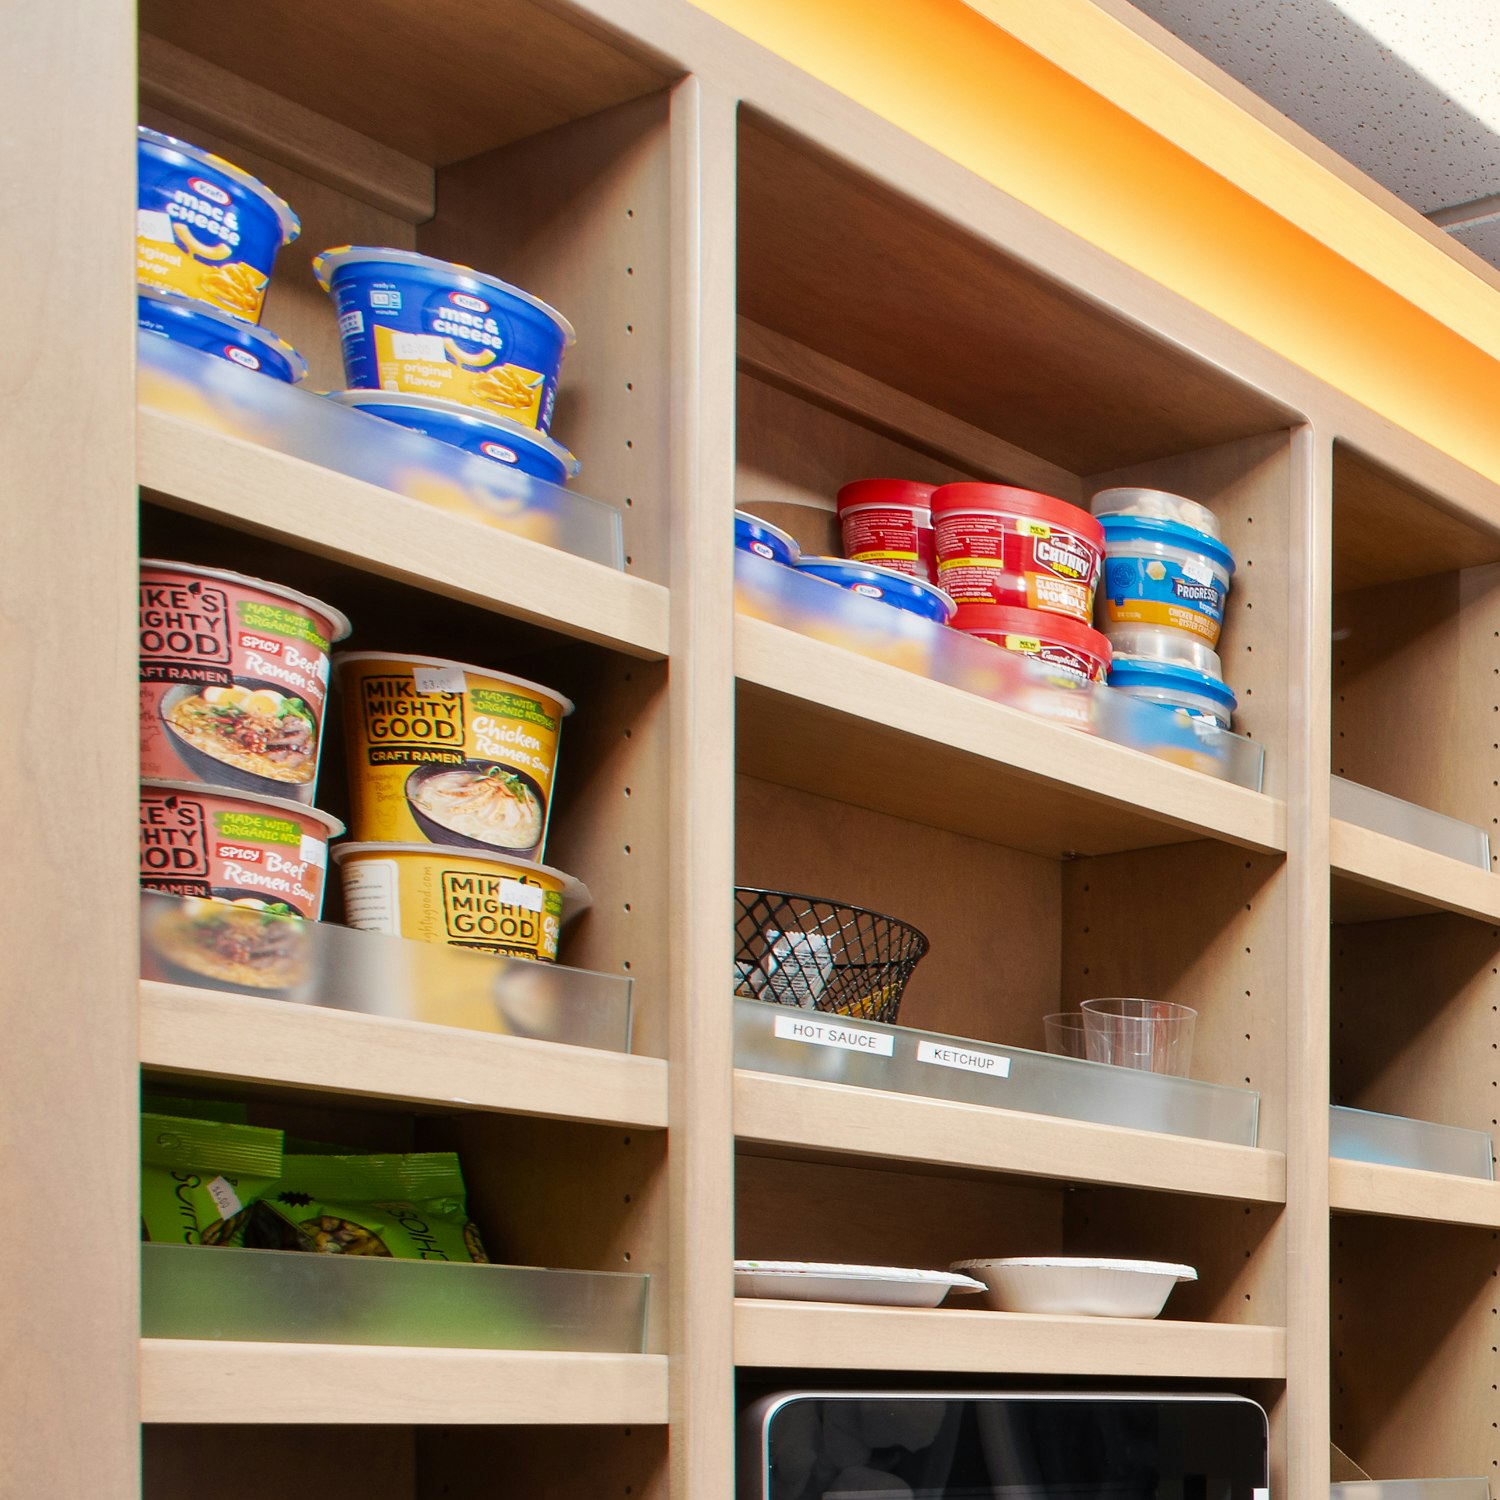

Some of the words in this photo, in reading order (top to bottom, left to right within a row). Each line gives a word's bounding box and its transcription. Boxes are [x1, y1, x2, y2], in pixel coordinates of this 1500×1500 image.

[223, 212, 238, 231] &
[439, 307, 483, 329] mac
[483, 316, 499, 335] &
[403, 363, 453, 379] original
[404, 375, 442, 389] flavor
[1039, 542, 1089, 576] CHUNKY
[1037, 589, 1086, 608] NOODLE
[248, 603, 281, 620] MADE
[244, 615, 297, 635] ORGANIC
[242, 636, 280, 654] SPICY
[285, 646, 319, 678] Beef
[169, 668, 228, 684] RAMEN
[245, 651, 305, 689] Ramen
[368, 701, 457, 718] MIGHTY
[477, 702, 525, 718] ORGANIC
[479, 691, 510, 704] MADE
[512, 699, 538, 711] WITH
[371, 719, 455, 739] GOOD
[472, 717, 540, 750] Chicken
[371, 751, 409, 761] CRAFT
[413, 751, 462, 764] RAMEN
[476, 734, 530, 765] Ramen
[224, 812, 260, 826] MADE
[264, 819, 294, 832] WITH
[222, 824, 277, 841] ORGANIC
[220, 847, 260, 861] SPICY
[265, 852, 307, 880] Beef
[223, 862, 291, 892] Ramen
[455, 915, 535, 938] GOOD
[793, 1024, 824, 1041] HOT
[828, 1030, 877, 1050] SAUCE
[934, 1049, 995, 1071] KETCHUP
